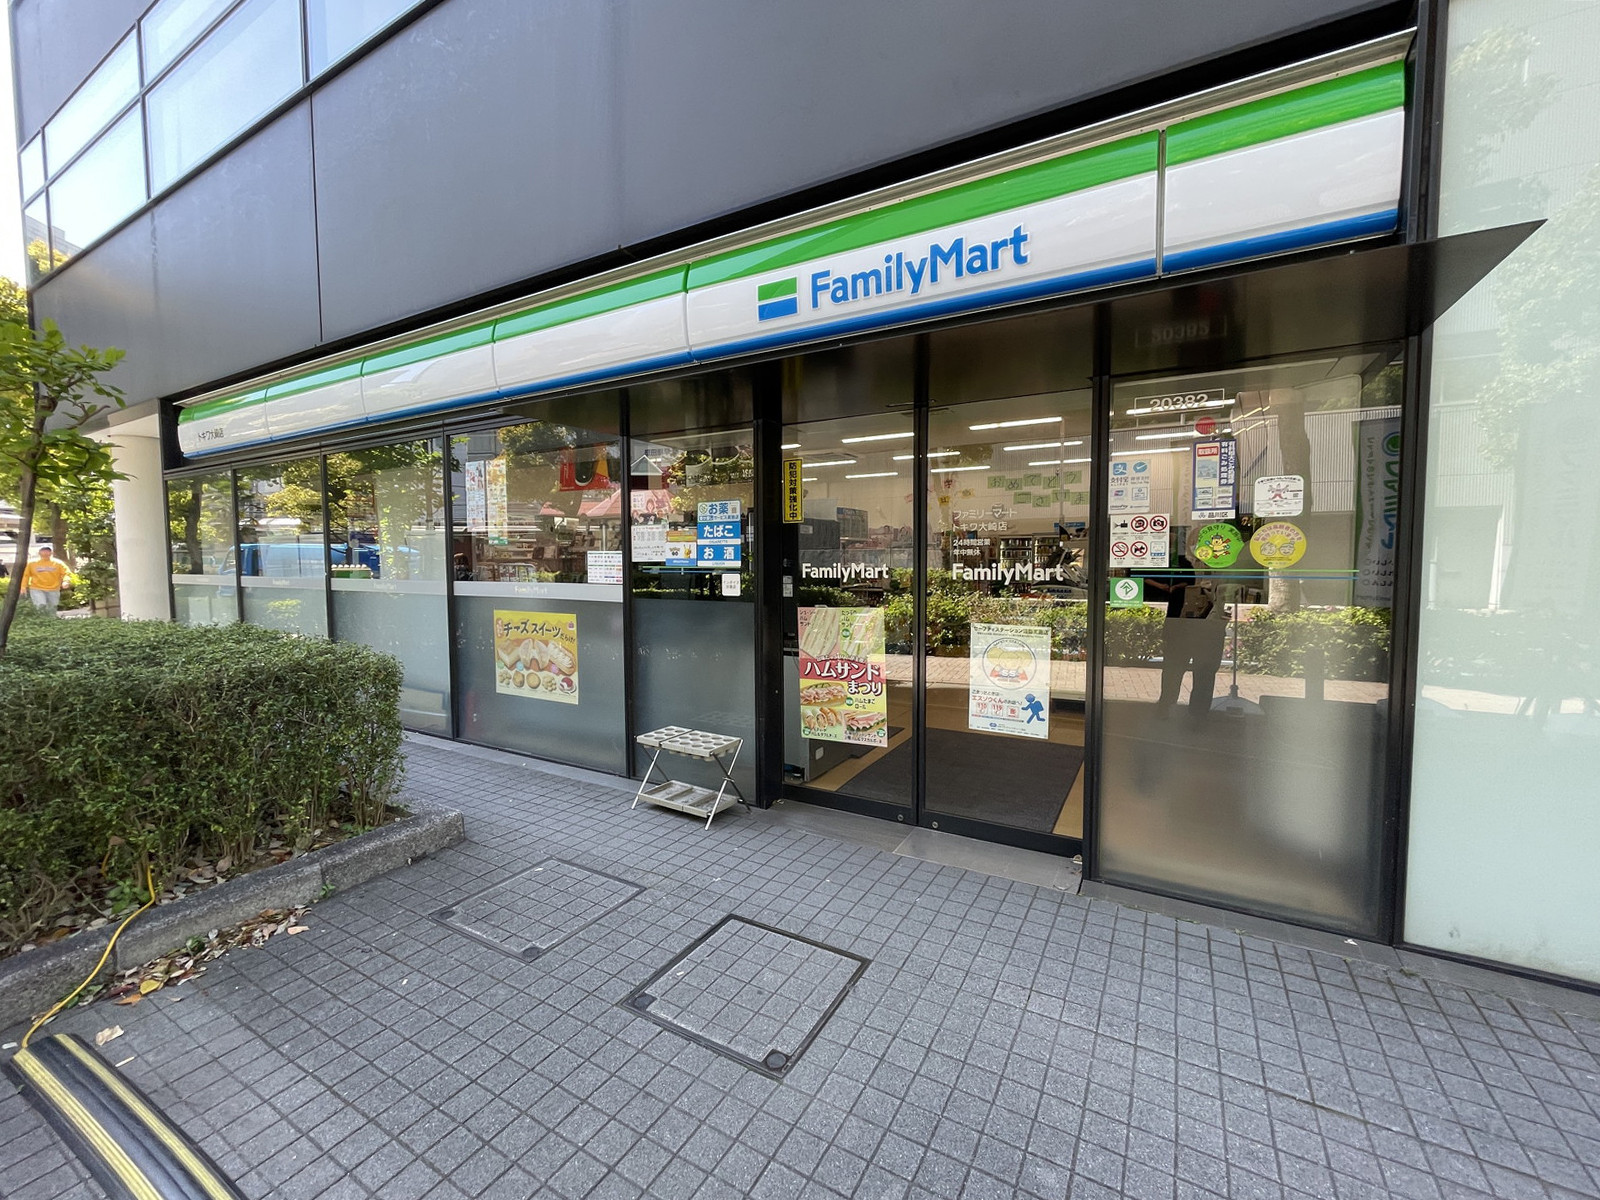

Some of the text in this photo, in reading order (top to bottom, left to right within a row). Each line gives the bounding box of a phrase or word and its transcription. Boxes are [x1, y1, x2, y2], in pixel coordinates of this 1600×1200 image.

[811, 224, 1029, 309] FamilyMart
[1149, 394, 1209, 412] 20382
[788, 462, 798, 519] 防犯対策強化中
[708, 502, 729, 514] お薬
[952, 507, 1018, 519] ファミリーマート
[703, 525, 734, 537] たばこ
[952, 522, 1008, 533] トキワ大崎店
[952, 538, 991, 546] 24時間営業
[802, 563, 889, 583] FamilyMart
[952, 562, 1064, 585] FamilyMart
[804, 661, 880, 681] ハムサンド
[848, 680, 883, 696] まつり
